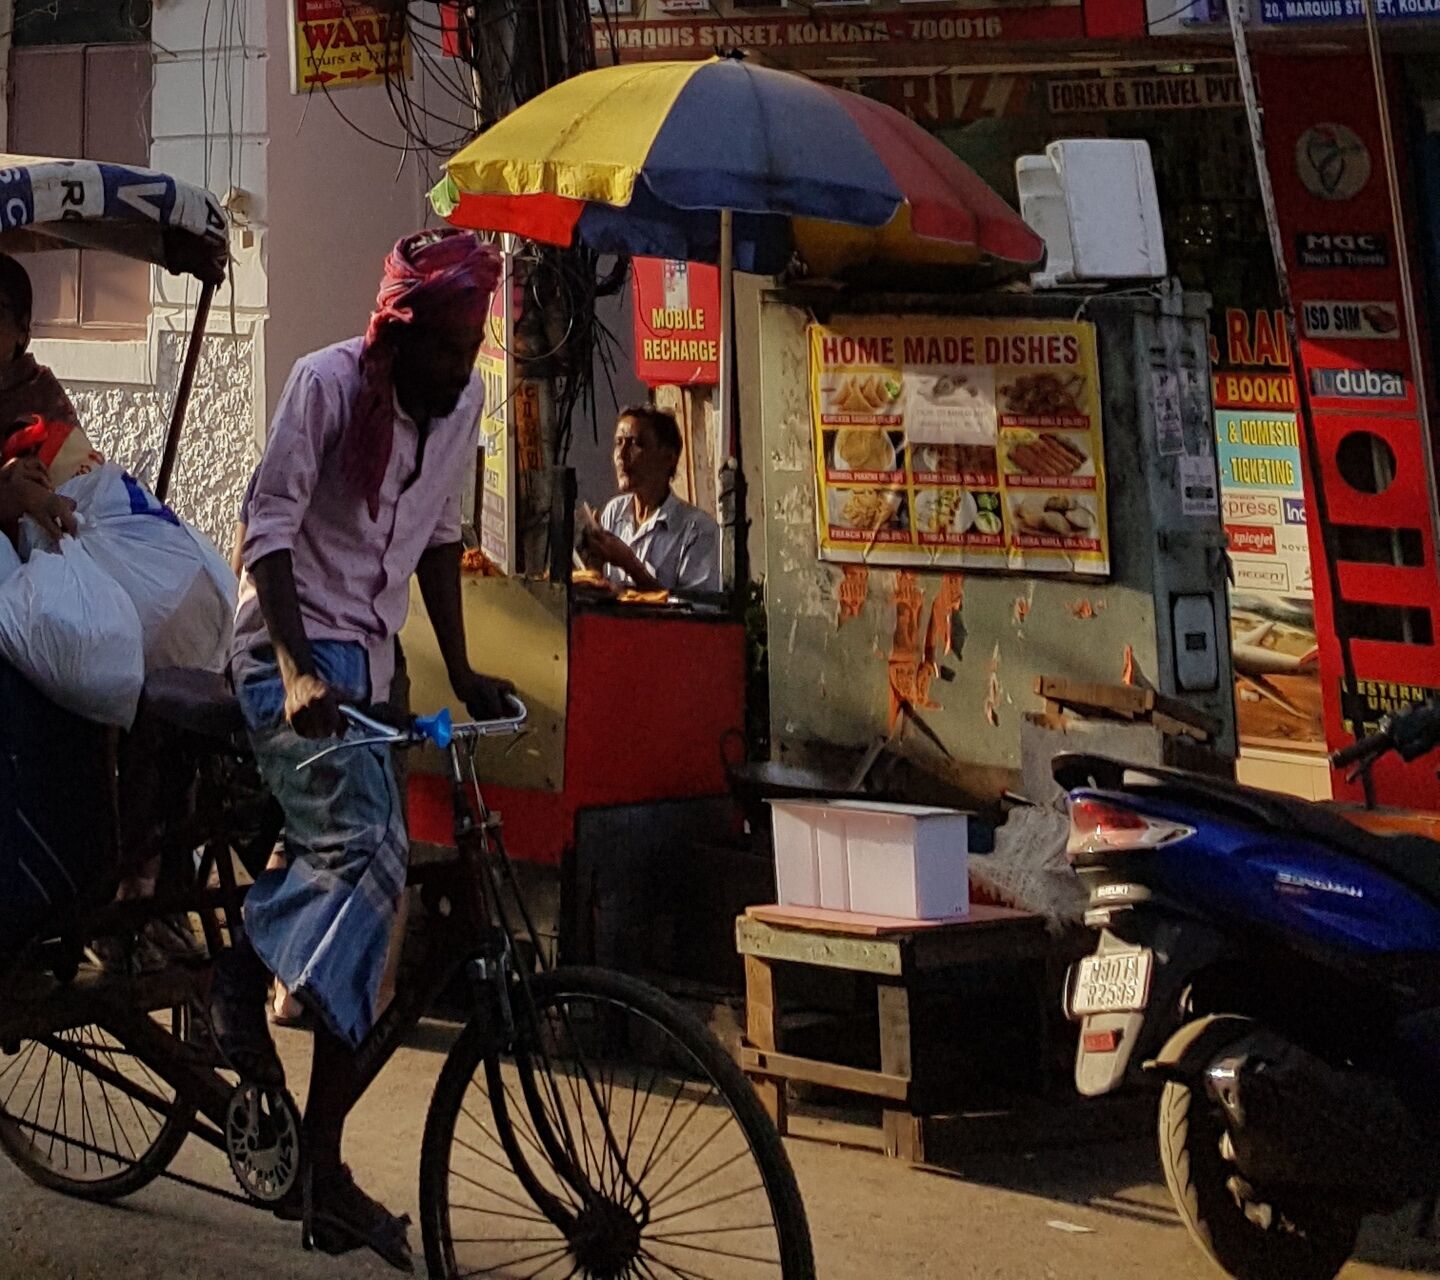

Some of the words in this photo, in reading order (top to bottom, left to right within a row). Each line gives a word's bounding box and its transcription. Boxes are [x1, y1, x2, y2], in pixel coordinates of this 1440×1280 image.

[1264, 1, 1284, 22] 20,
[1286, 0, 1342, 18] MARQUIS
[596, 26, 696, 50] MARQUIS
[788, 20, 890, 45] KOLKATA
[910, 16, 1003, 40] 700016
[304, 53, 346, 68] Tours
[1052, 82, 1109, 110] FOREX
[1130, 78, 1198, 106] TRAVEL
[652, 307, 705, 330] MOBILE
[1305, 305, 1330, 330] ISD
[1333, 306, 1361, 330] SIM
[644, 339, 718, 362] RECHARGE
[823, 335, 895, 365] HOME
[904, 336, 975, 365] MADE
[985, 336, 1079, 365] DISHES
[1227, 420, 1238, 444] &
[1230, 457, 1295, 486] TICKETING
